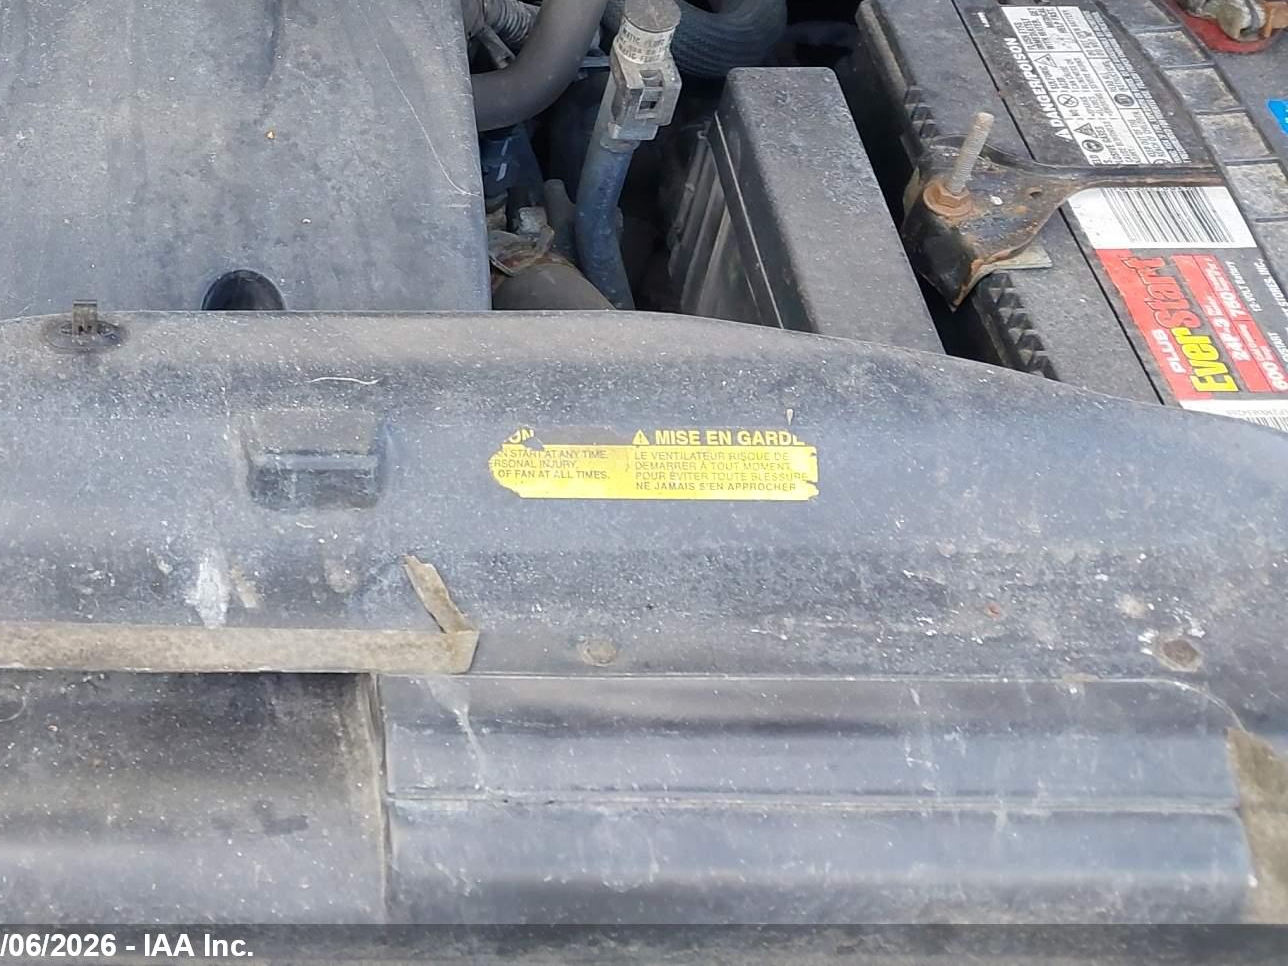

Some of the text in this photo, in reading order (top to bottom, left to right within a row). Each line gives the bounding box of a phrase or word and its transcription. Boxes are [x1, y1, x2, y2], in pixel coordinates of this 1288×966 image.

[1119, 257, 1238, 392] EverStart
[1150, 329, 1186, 374] PLUS
[655, 430, 701, 445] MISE
[706, 430, 732, 445] EN
[545, 450, 558, 458] AT
[558, 450, 581, 458] ANY
[634, 451, 789, 461] LE VENTILATEUR RISQUE DE
[494, 459, 537, 468] RSONAL
[711, 462, 740, 471] TOUT
[497, 469, 512, 478] OF
[514, 469, 536, 478] FAN
[538, 469, 550, 478] AT
[635, 471, 666, 481] POUR
[711, 472, 748, 481] TOUTE
[636, 481, 650, 490] NE
[654, 482, 695, 491] JAMAIS
